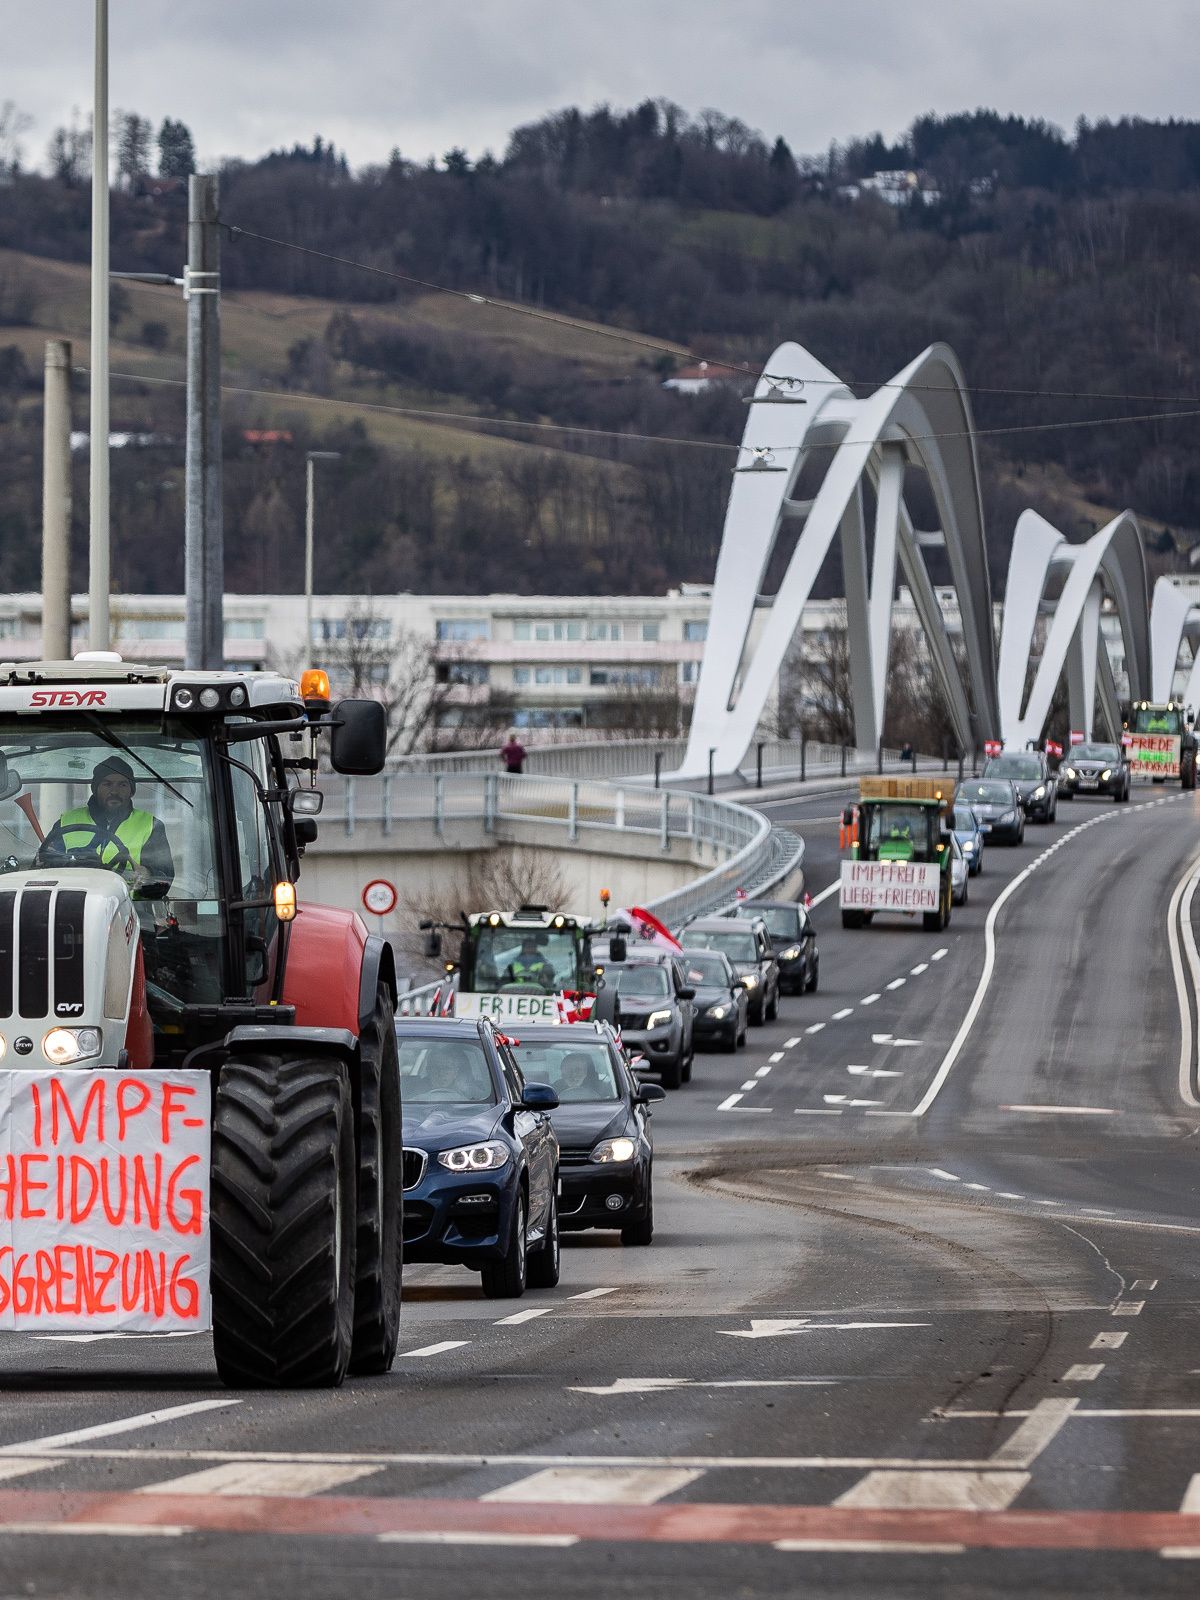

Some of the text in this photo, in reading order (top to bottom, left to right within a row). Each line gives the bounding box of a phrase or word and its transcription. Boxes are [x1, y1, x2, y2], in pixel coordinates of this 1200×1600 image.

[29, 691, 107, 707] STEYR
[843, 886, 936, 906] LIEBE FRIEDEN
[56, 1002, 83, 1012] CVT
[480, 996, 554, 1015] FRIEDE
[31, 1078, 204, 1147] IMPF-
